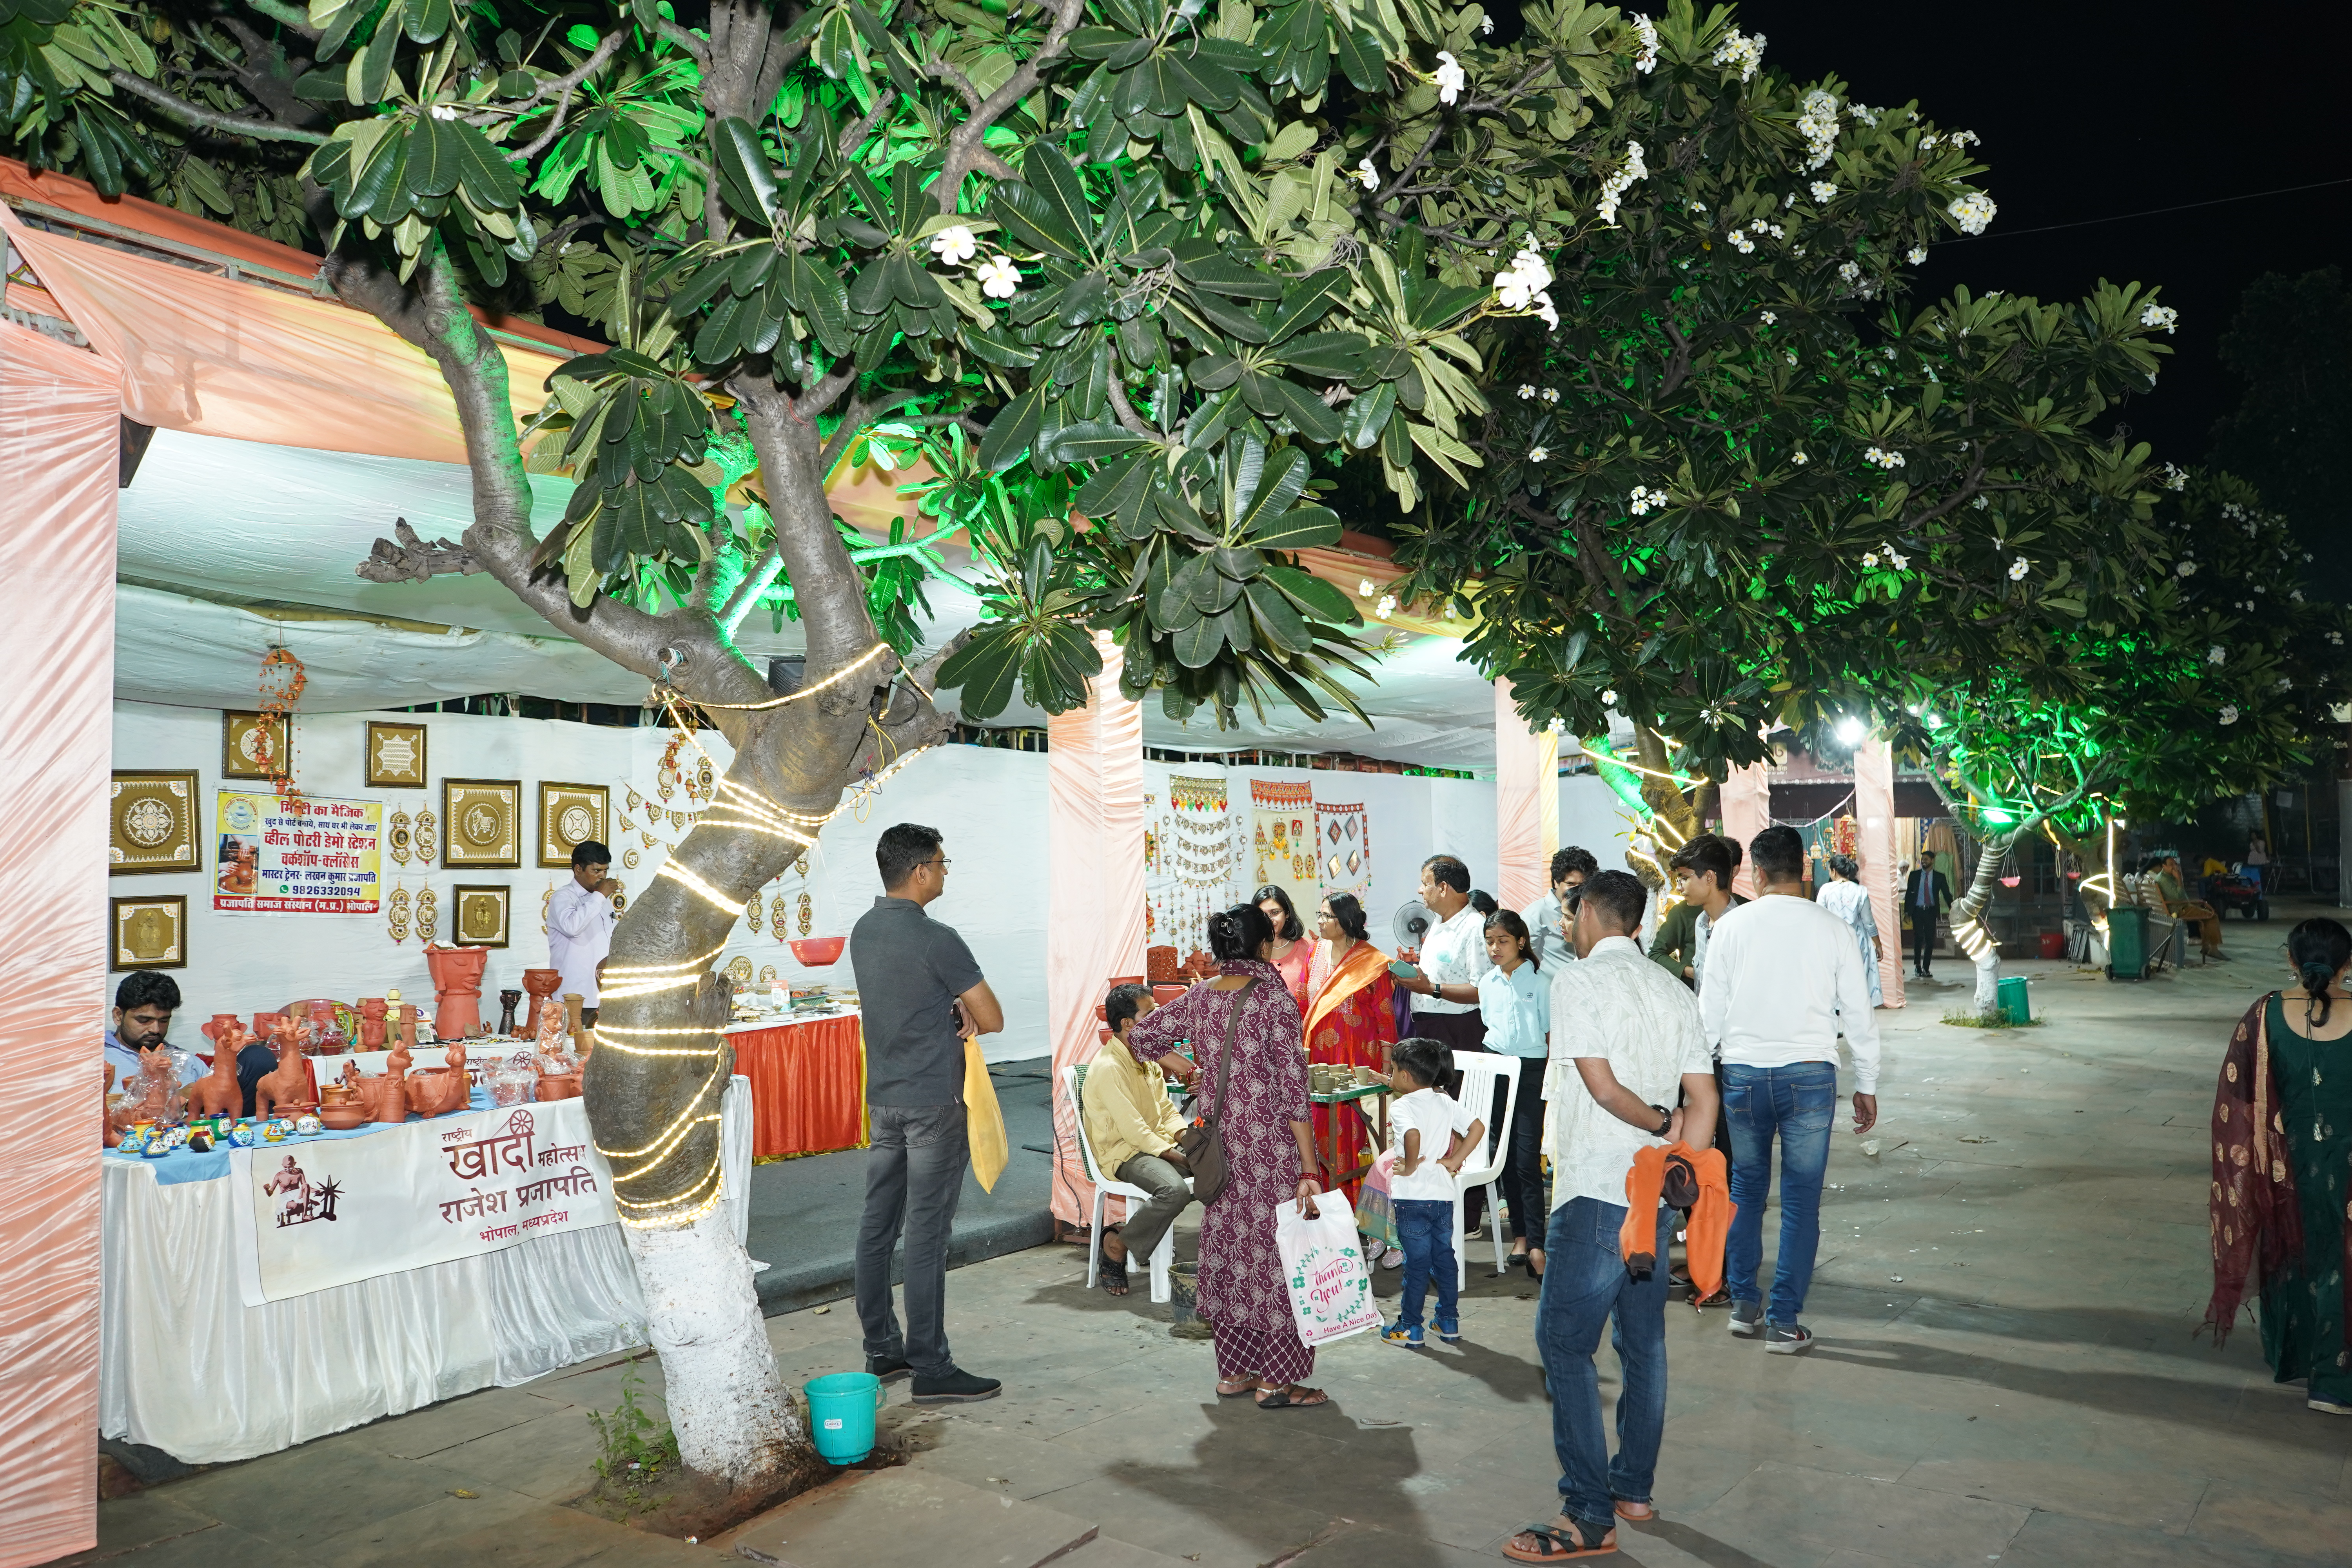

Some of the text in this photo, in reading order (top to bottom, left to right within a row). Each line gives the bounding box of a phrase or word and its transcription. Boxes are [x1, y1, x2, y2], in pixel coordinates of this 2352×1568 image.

[314, 806, 328, 816] का
[331, 804, 364, 818] मैजिक
[265, 818, 276, 828] खुद
[278, 817, 283, 826] से
[341, 821, 348, 829] भी
[349, 821, 363, 830] लेकर
[365, 823, 377, 831] जाएं
[264, 829, 377, 850] व्हील पोटरी डेमो स्टेशन
[262, 869, 283, 879] मास्टर
[305, 871, 327, 881] लखन
[327, 872, 347, 884] कुमार
[348, 871, 376, 883] प्रजापति
[292, 886, 360, 896] 9826332094
[220, 897, 254, 908] प्रजापति
[256, 900, 283, 909] समाज
[284, 898, 312, 910] संस्थान
[347, 900, 374, 911] भोपाल
[441, 1128, 473, 1142] राष्ट्रीय
[439, 1166, 597, 1224] राजेश प्रजापति
[522, 1209, 568, 1232] मध्यप्रदेश
[1323, 1325, 1341, 1334] Have
[1349, 1316, 1364, 1325] Nice
[1365, 1311, 1377, 1320] Day
